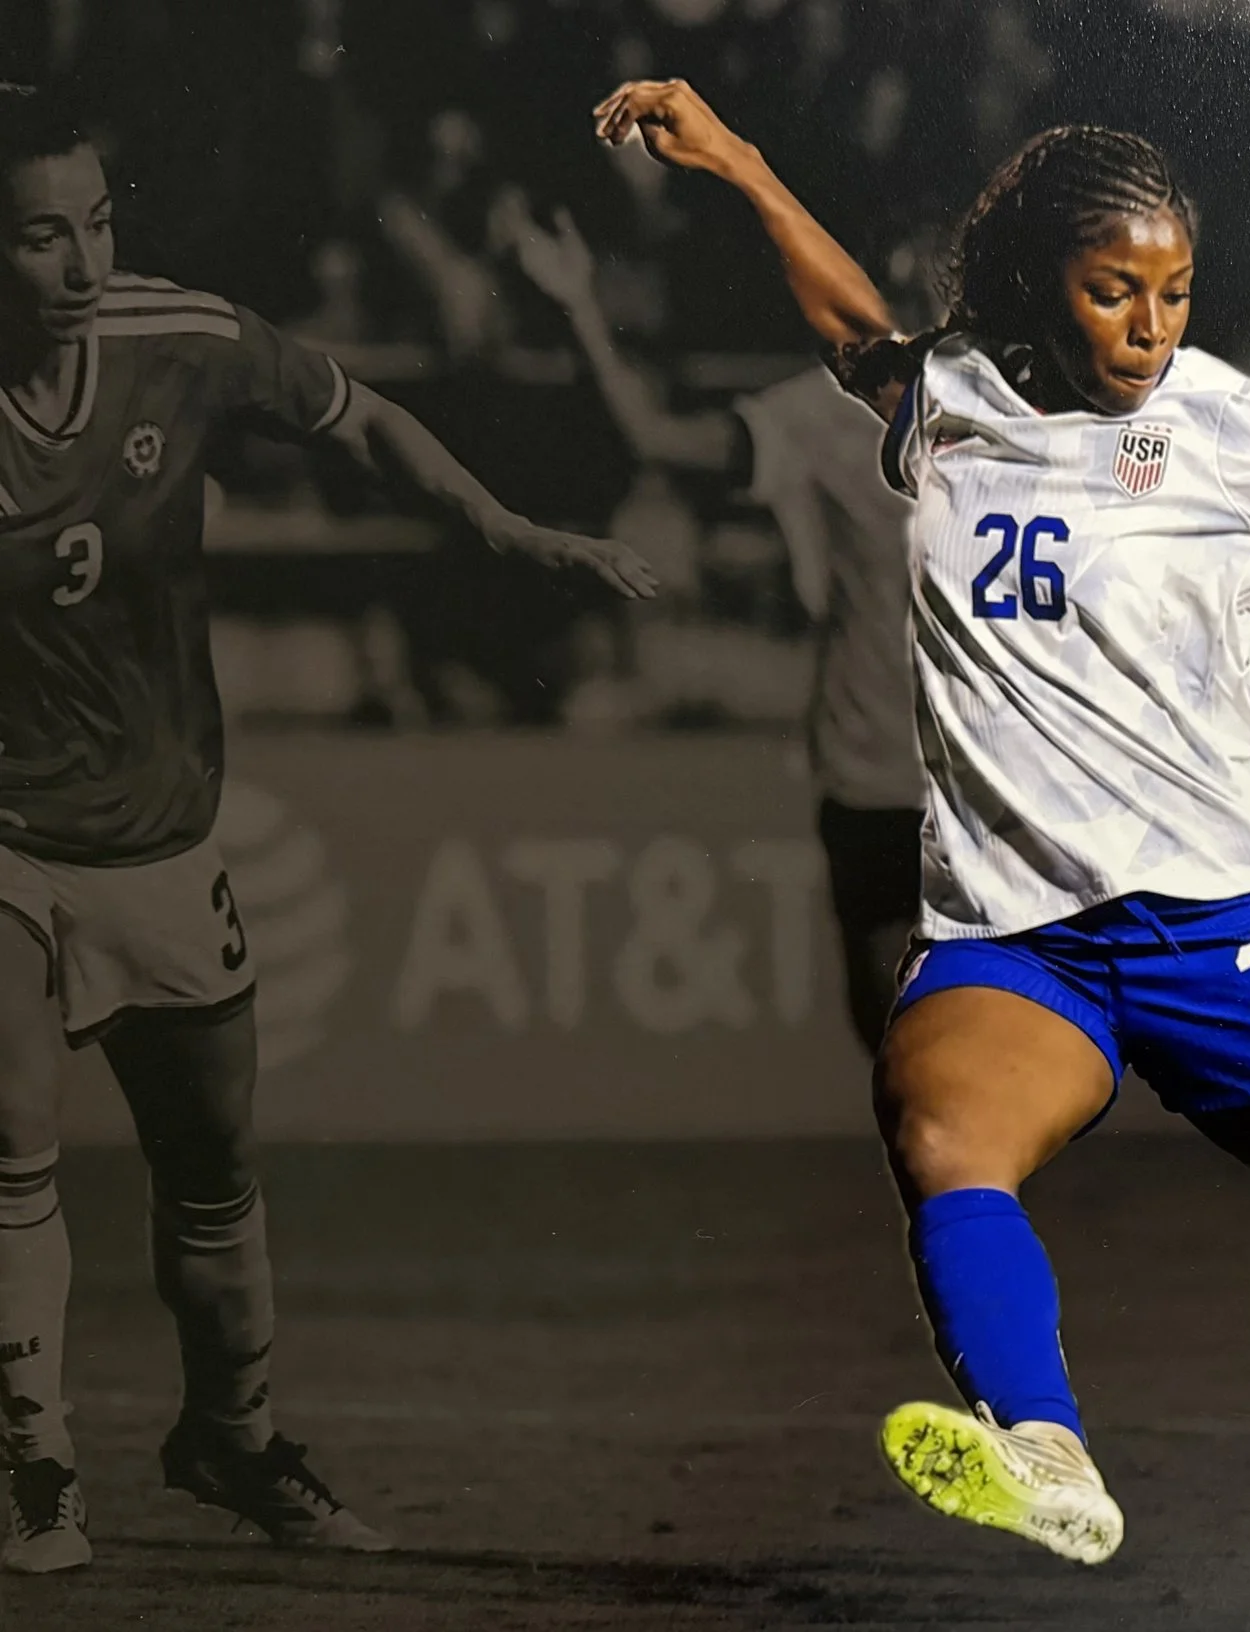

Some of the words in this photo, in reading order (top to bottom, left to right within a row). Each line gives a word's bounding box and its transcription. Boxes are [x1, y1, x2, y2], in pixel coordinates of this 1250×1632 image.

[1121, 433, 1166, 463] USA
[53, 521, 103, 607] 3
[971, 512, 1071, 622] 26
[211, 869, 248, 972] 3
[392, 835, 826, 1033] AT&T
